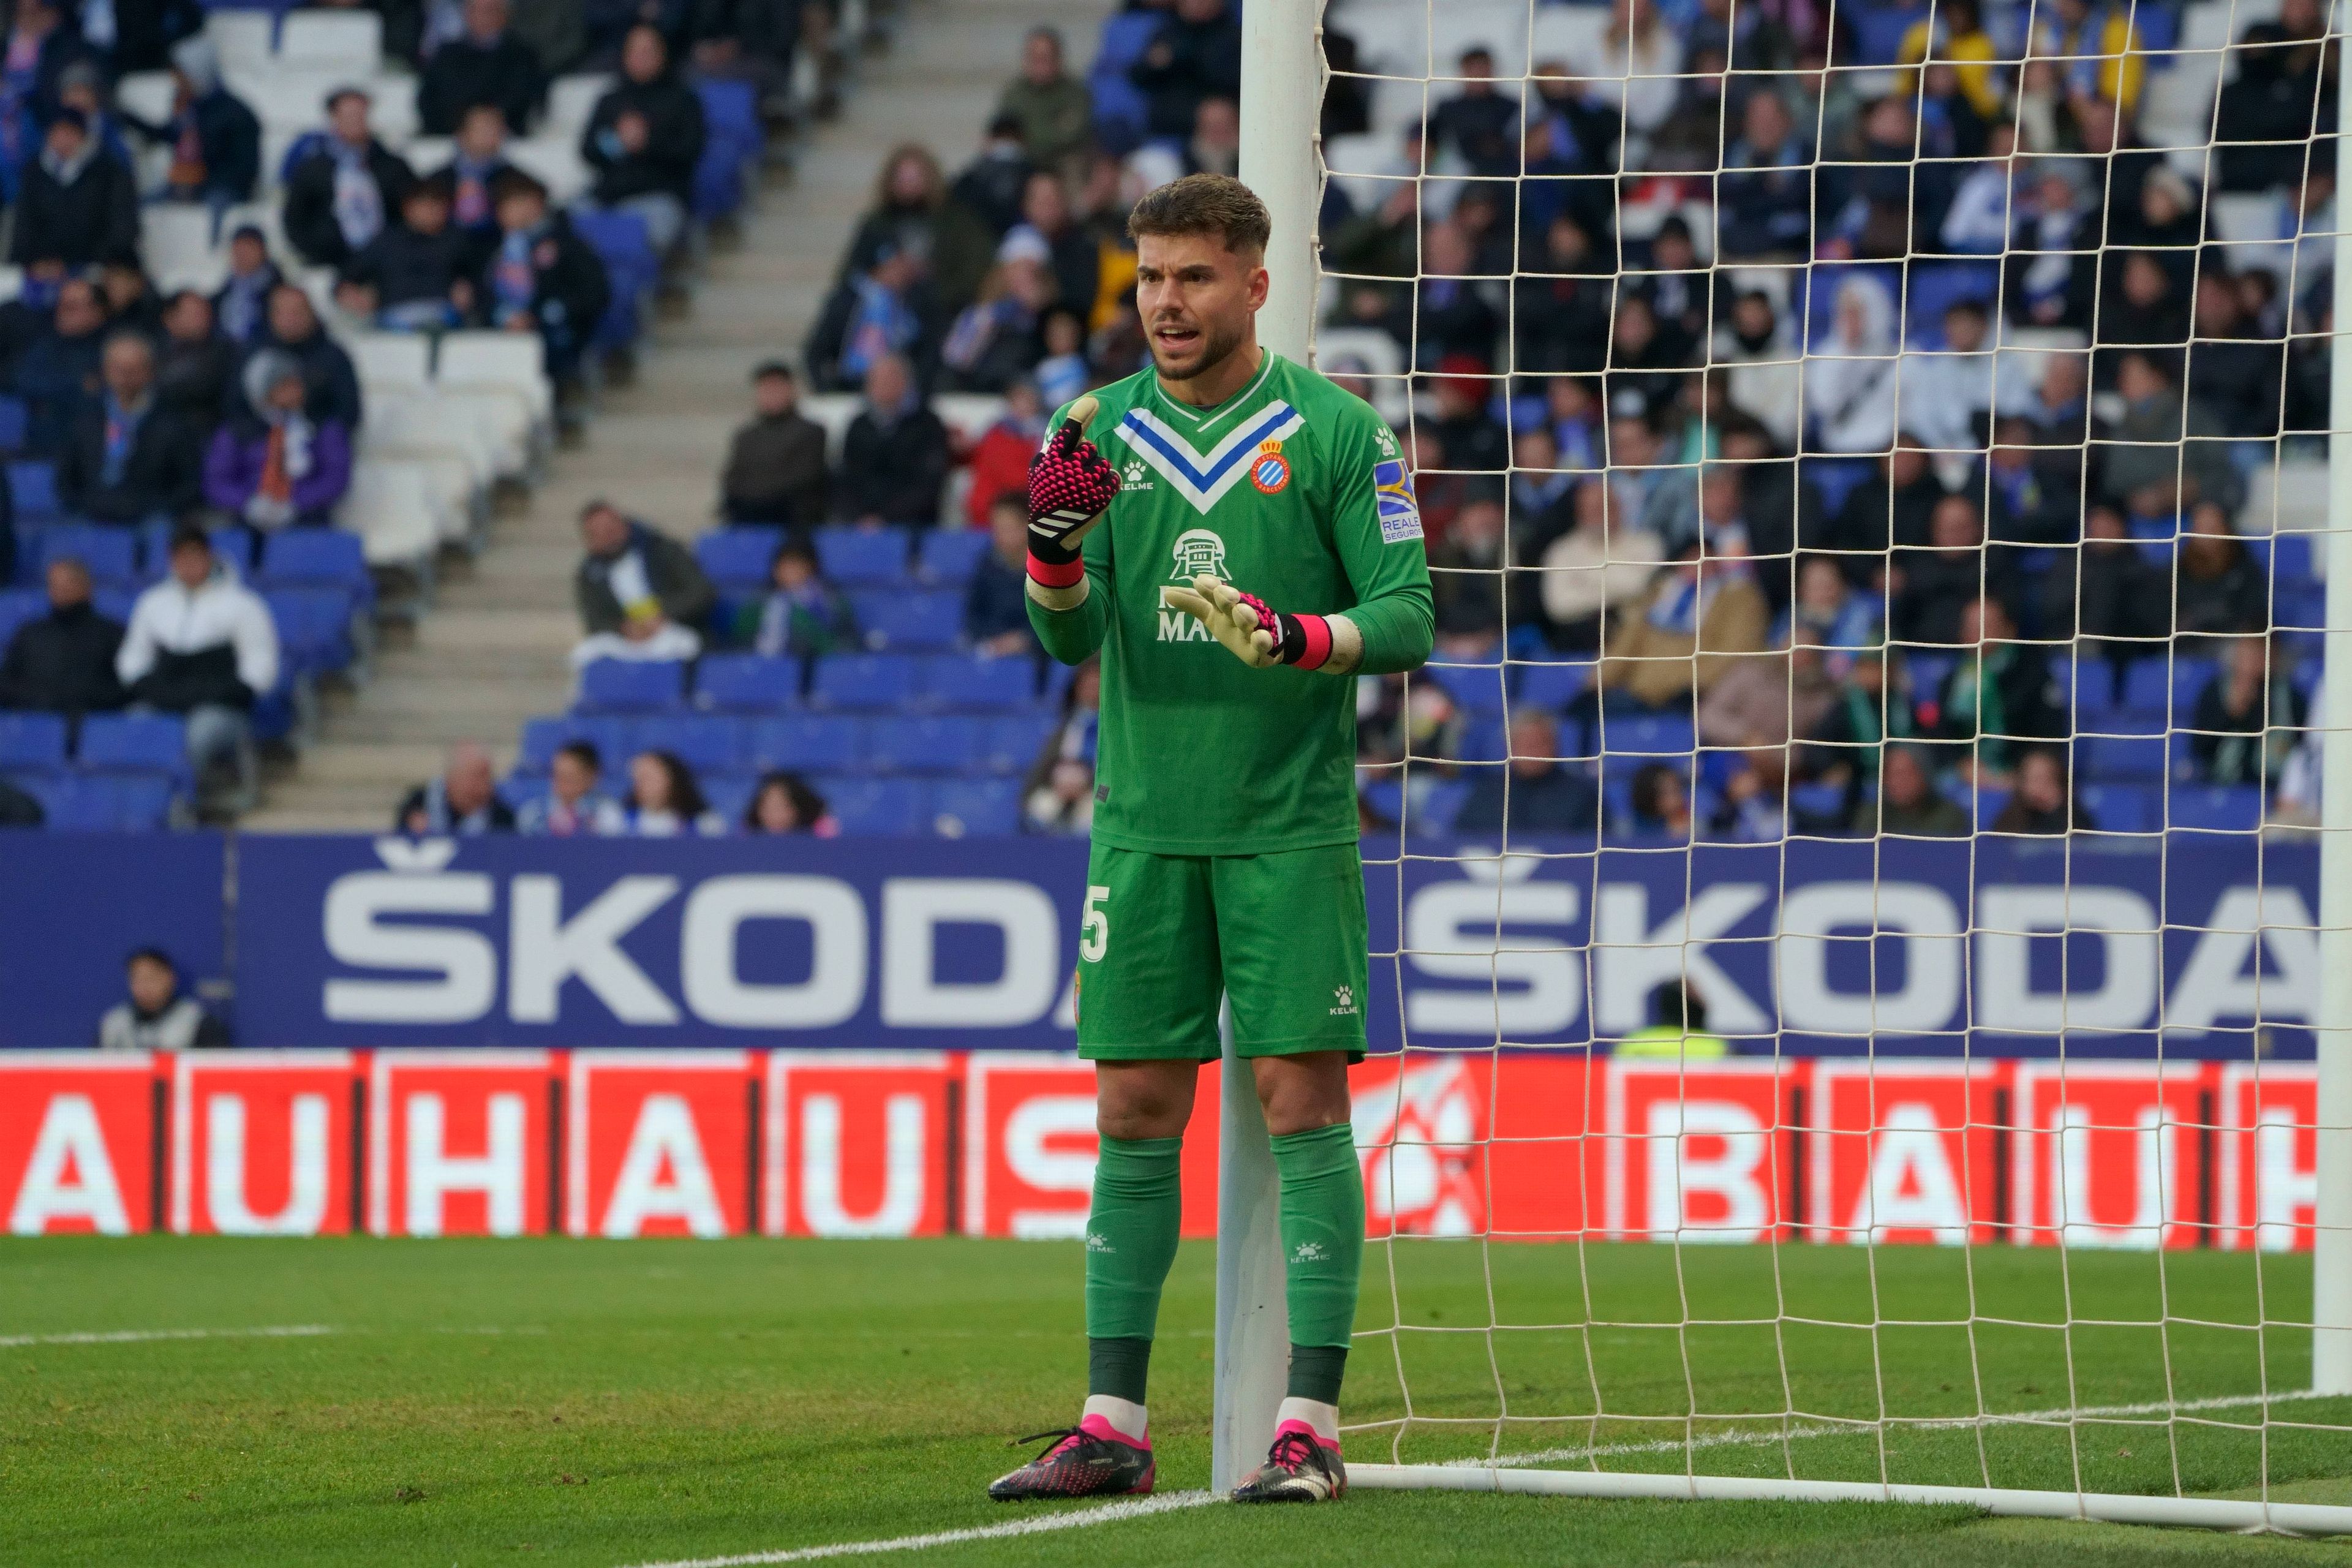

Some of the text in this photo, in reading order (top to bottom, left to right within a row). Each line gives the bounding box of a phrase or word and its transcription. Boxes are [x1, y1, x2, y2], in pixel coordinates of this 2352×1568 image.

[1262, 454, 1289, 472] ESPANYOL
[1259, 475, 1289, 492] BARCELONA
[1382, 517, 1420, 532] REALE
[1385, 529, 1422, 541] SEGUROS
[1156, 611, 1219, 643] MA
[322, 837, 1078, 1030] ŠKOD
[1407, 846, 2320, 1038] ŠKODA
[1290, 1254, 1332, 1264] KELME
